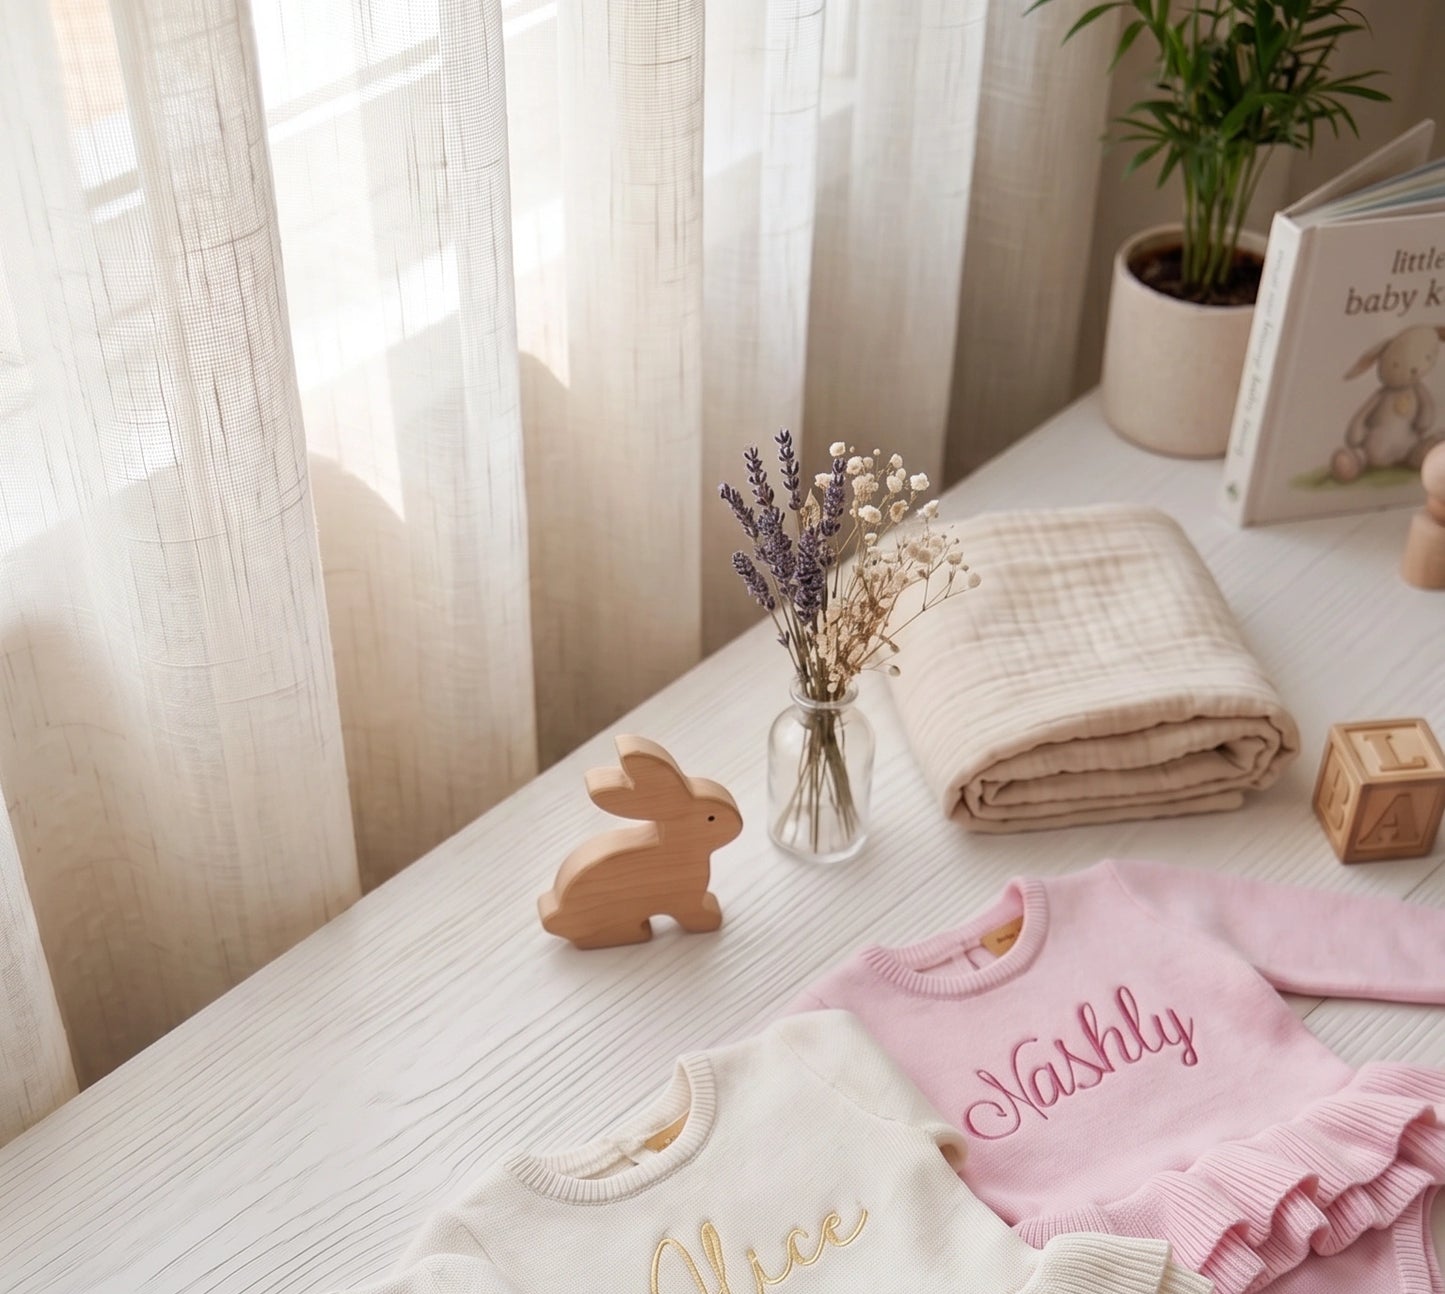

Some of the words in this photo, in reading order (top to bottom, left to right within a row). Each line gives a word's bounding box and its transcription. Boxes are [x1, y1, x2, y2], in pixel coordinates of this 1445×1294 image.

[1391, 245, 1445, 274] little
[1344, 283, 1419, 318] baby
[1358, 793, 1421, 845] A
[965, 985, 1197, 1141] Nashly
